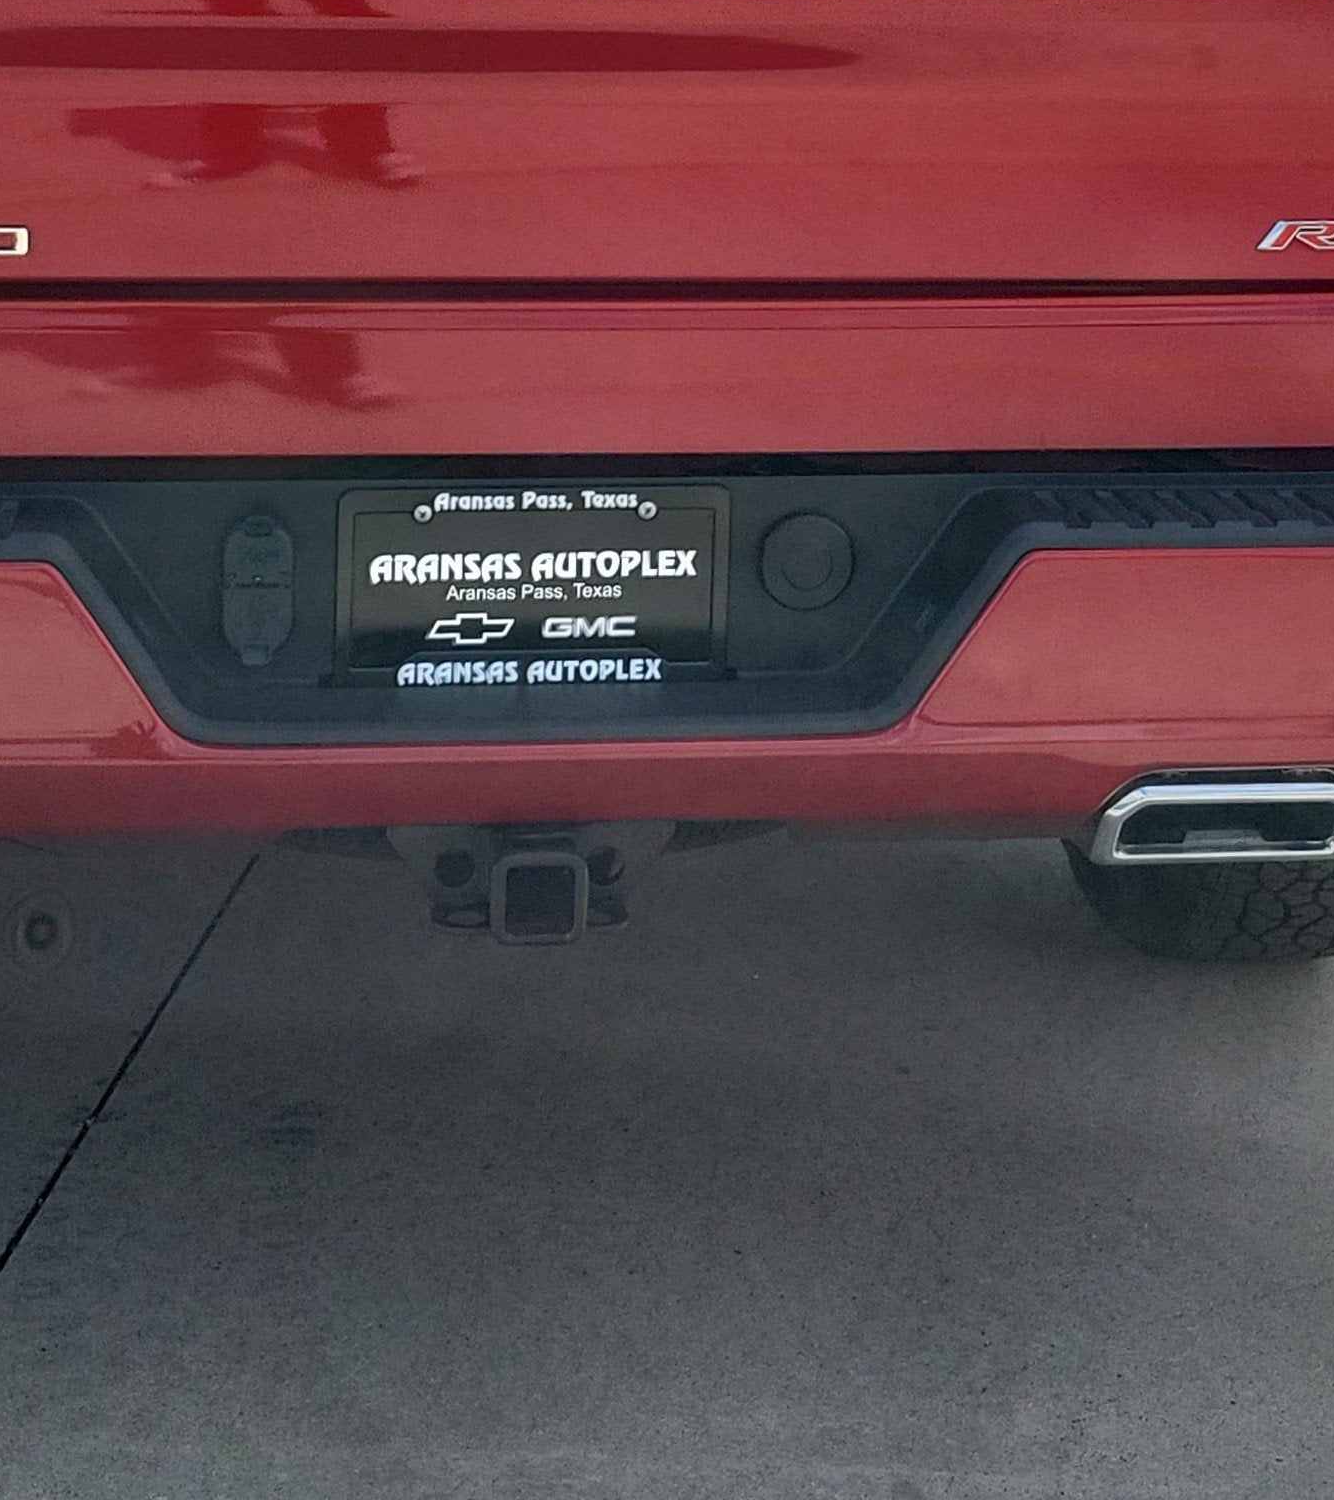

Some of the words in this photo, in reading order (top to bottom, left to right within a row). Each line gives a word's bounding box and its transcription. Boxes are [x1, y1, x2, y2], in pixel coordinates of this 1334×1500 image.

[433, 492, 515, 512] Aransas
[521, 491, 573, 510] Pass,
[581, 490, 638, 509] Texas
[369, 552, 522, 585] ARANSAS
[531, 550, 697, 581] AUTOPLEX
[445, 584, 516, 600] Aransas
[521, 584, 568, 600] Pass,
[572, 583, 622, 599] Texas
[541, 615, 638, 638] GMC
[396, 660, 518, 687] ARANSAS
[526, 658, 662, 685] AUTOPLEX
